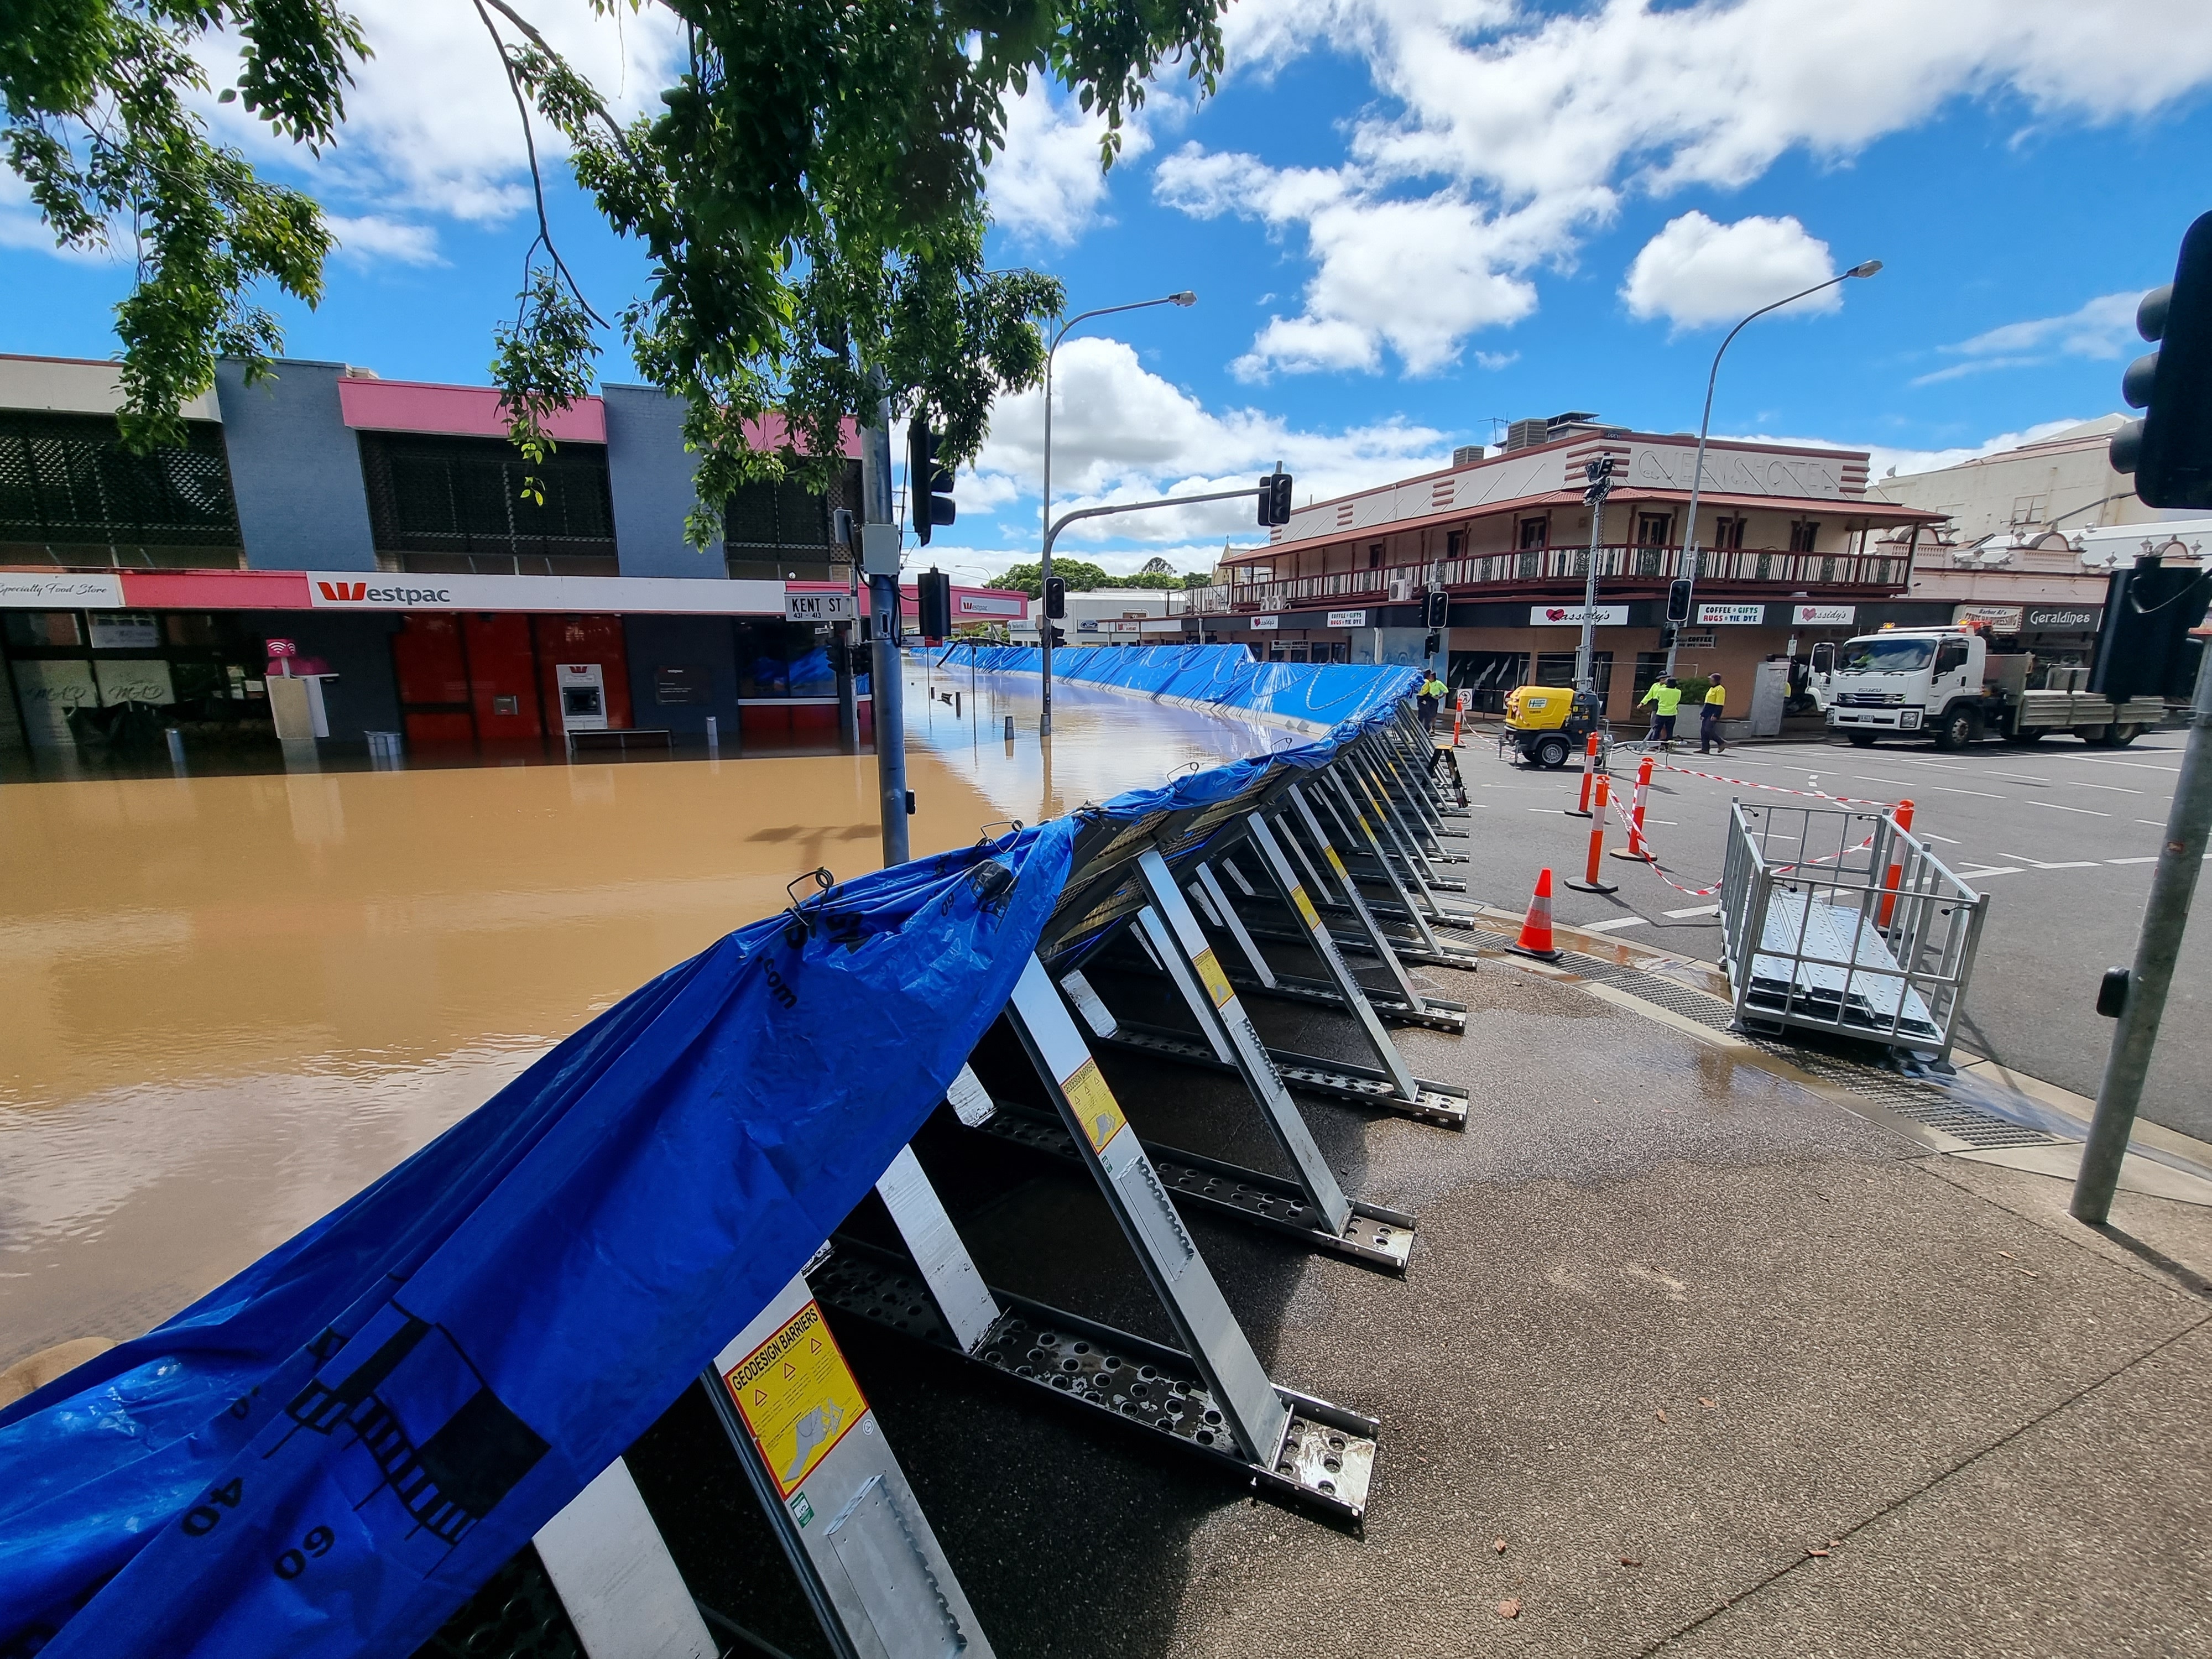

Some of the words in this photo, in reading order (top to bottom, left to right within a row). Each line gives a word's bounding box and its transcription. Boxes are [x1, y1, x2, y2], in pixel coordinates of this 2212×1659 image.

[45, 582, 75, 594] Food
[76, 583, 107, 595] Store
[317, 582, 451, 606] Westpac
[792, 598, 821, 612] KENT
[828, 598, 841, 612] ST
[963, 602, 988, 611] Westpac
[2030, 610, 2091, 625] Geraldines
[732, 1340, 781, 1391] GEODESIGN
[780, 1308, 818, 1350] BARRIERS
